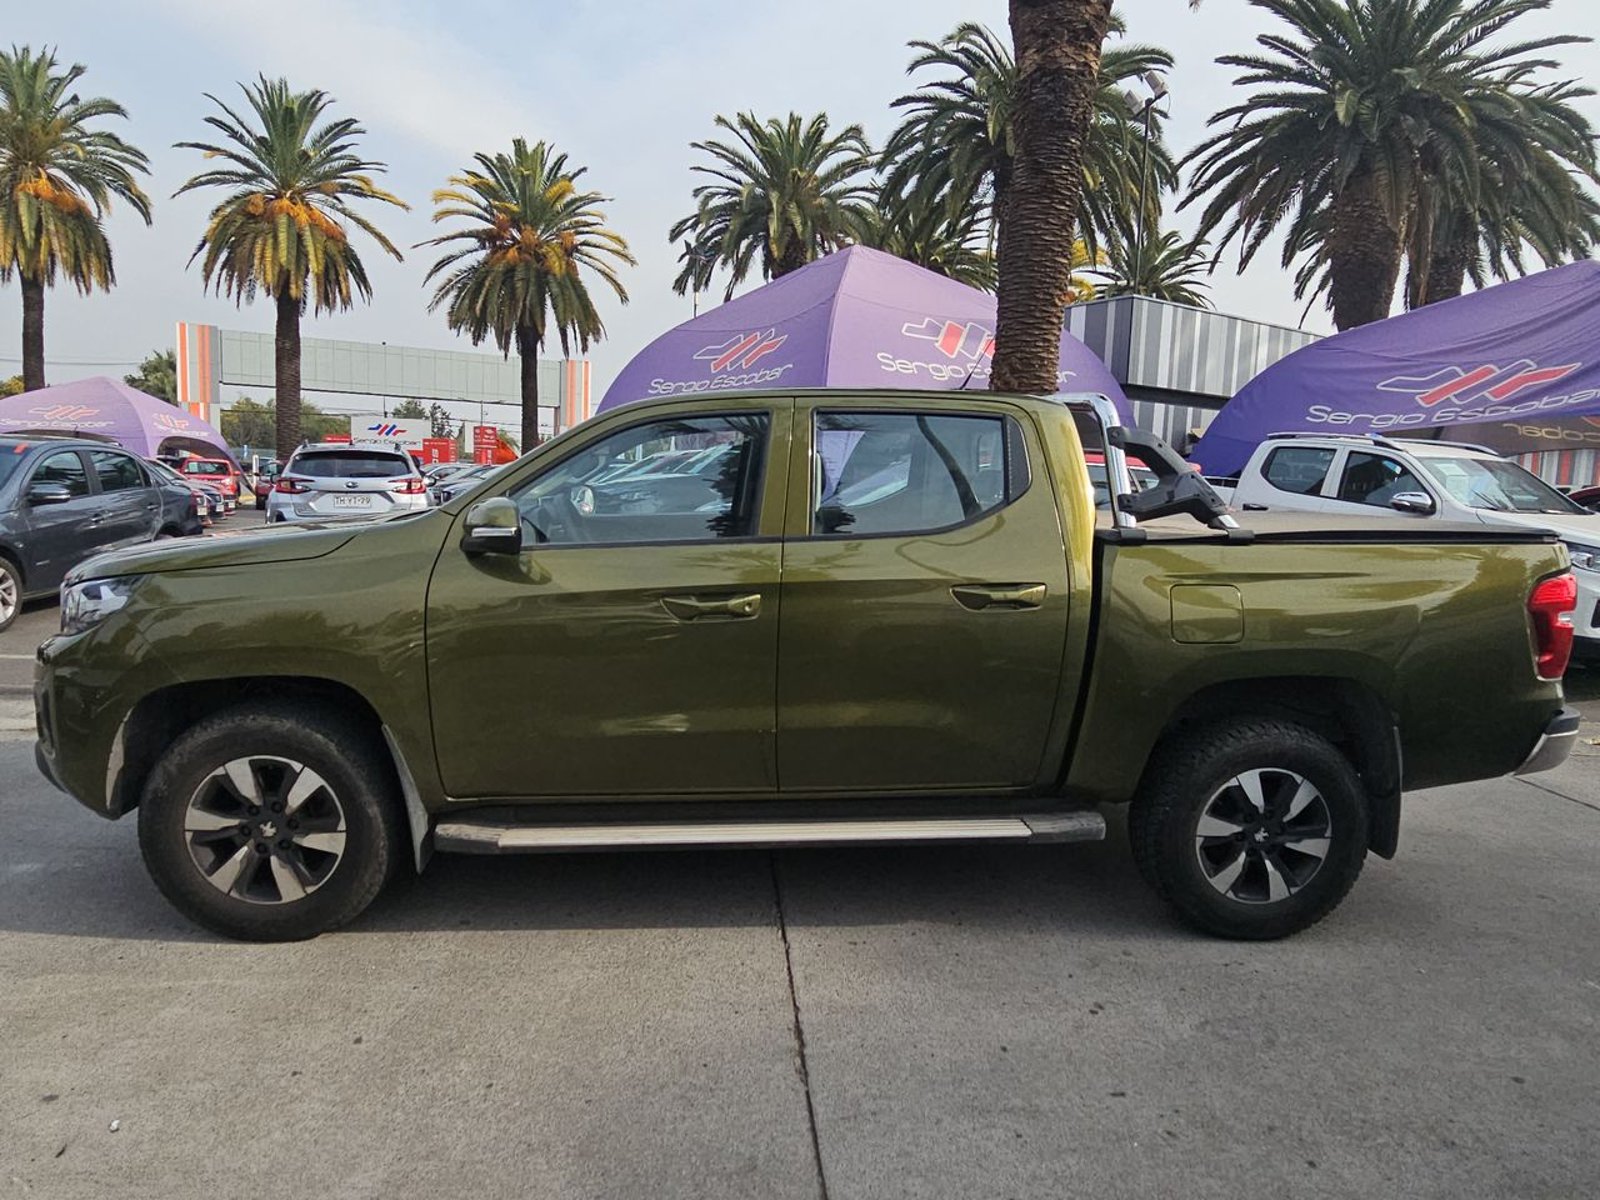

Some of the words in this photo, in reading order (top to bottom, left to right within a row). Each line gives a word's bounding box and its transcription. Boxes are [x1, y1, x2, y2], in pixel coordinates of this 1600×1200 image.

[711, 364, 793, 389] Escobar
[877, 352, 965, 381] Sergio
[1306, 405, 1426, 428] Sergio
[1431, 389, 1600, 423] Escoba
